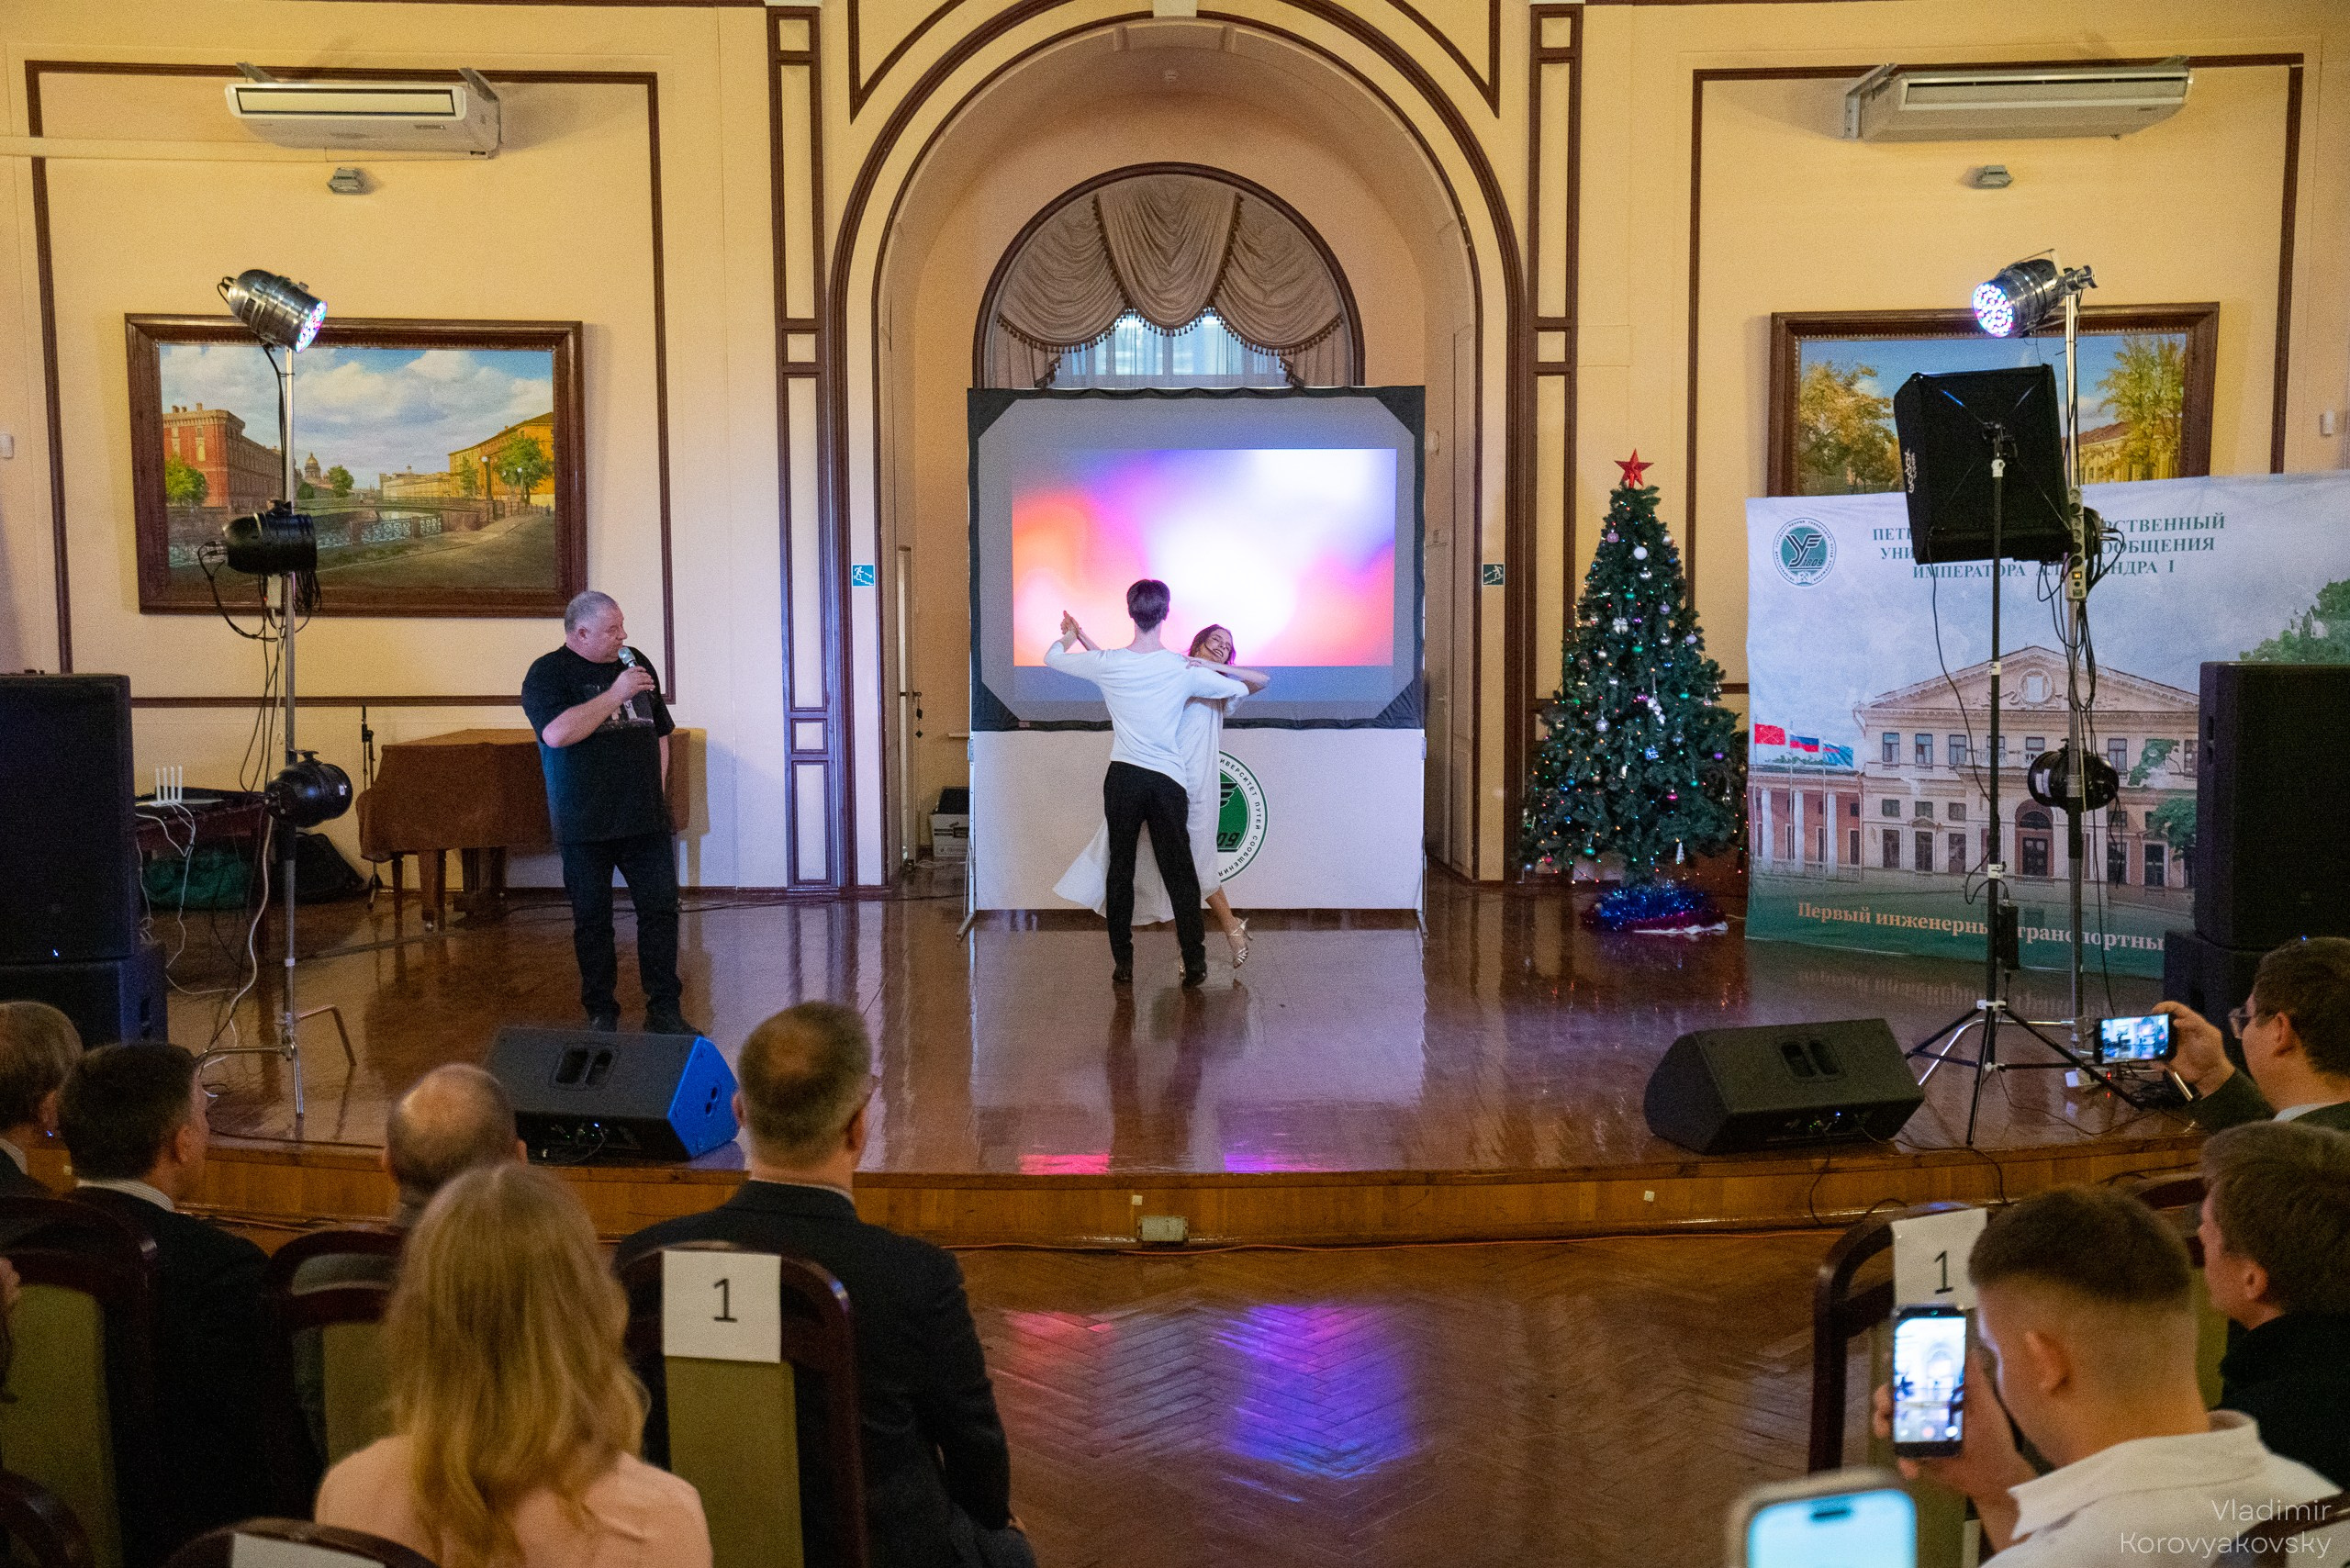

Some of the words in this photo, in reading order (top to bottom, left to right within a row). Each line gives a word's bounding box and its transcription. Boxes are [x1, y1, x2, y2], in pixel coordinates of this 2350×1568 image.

[1219, 758, 1258, 796] ИВЕРСИТЕТ
[1254, 801, 1262, 830] ПУТЕЙ
[1216, 832, 1240, 847] 09
[1218, 835, 1259, 877] СООБЩЕНИЯ
[1797, 901, 1871, 924] Первый
[1934, 1250, 1954, 1294] 1
[713, 1278, 738, 1322] 1
